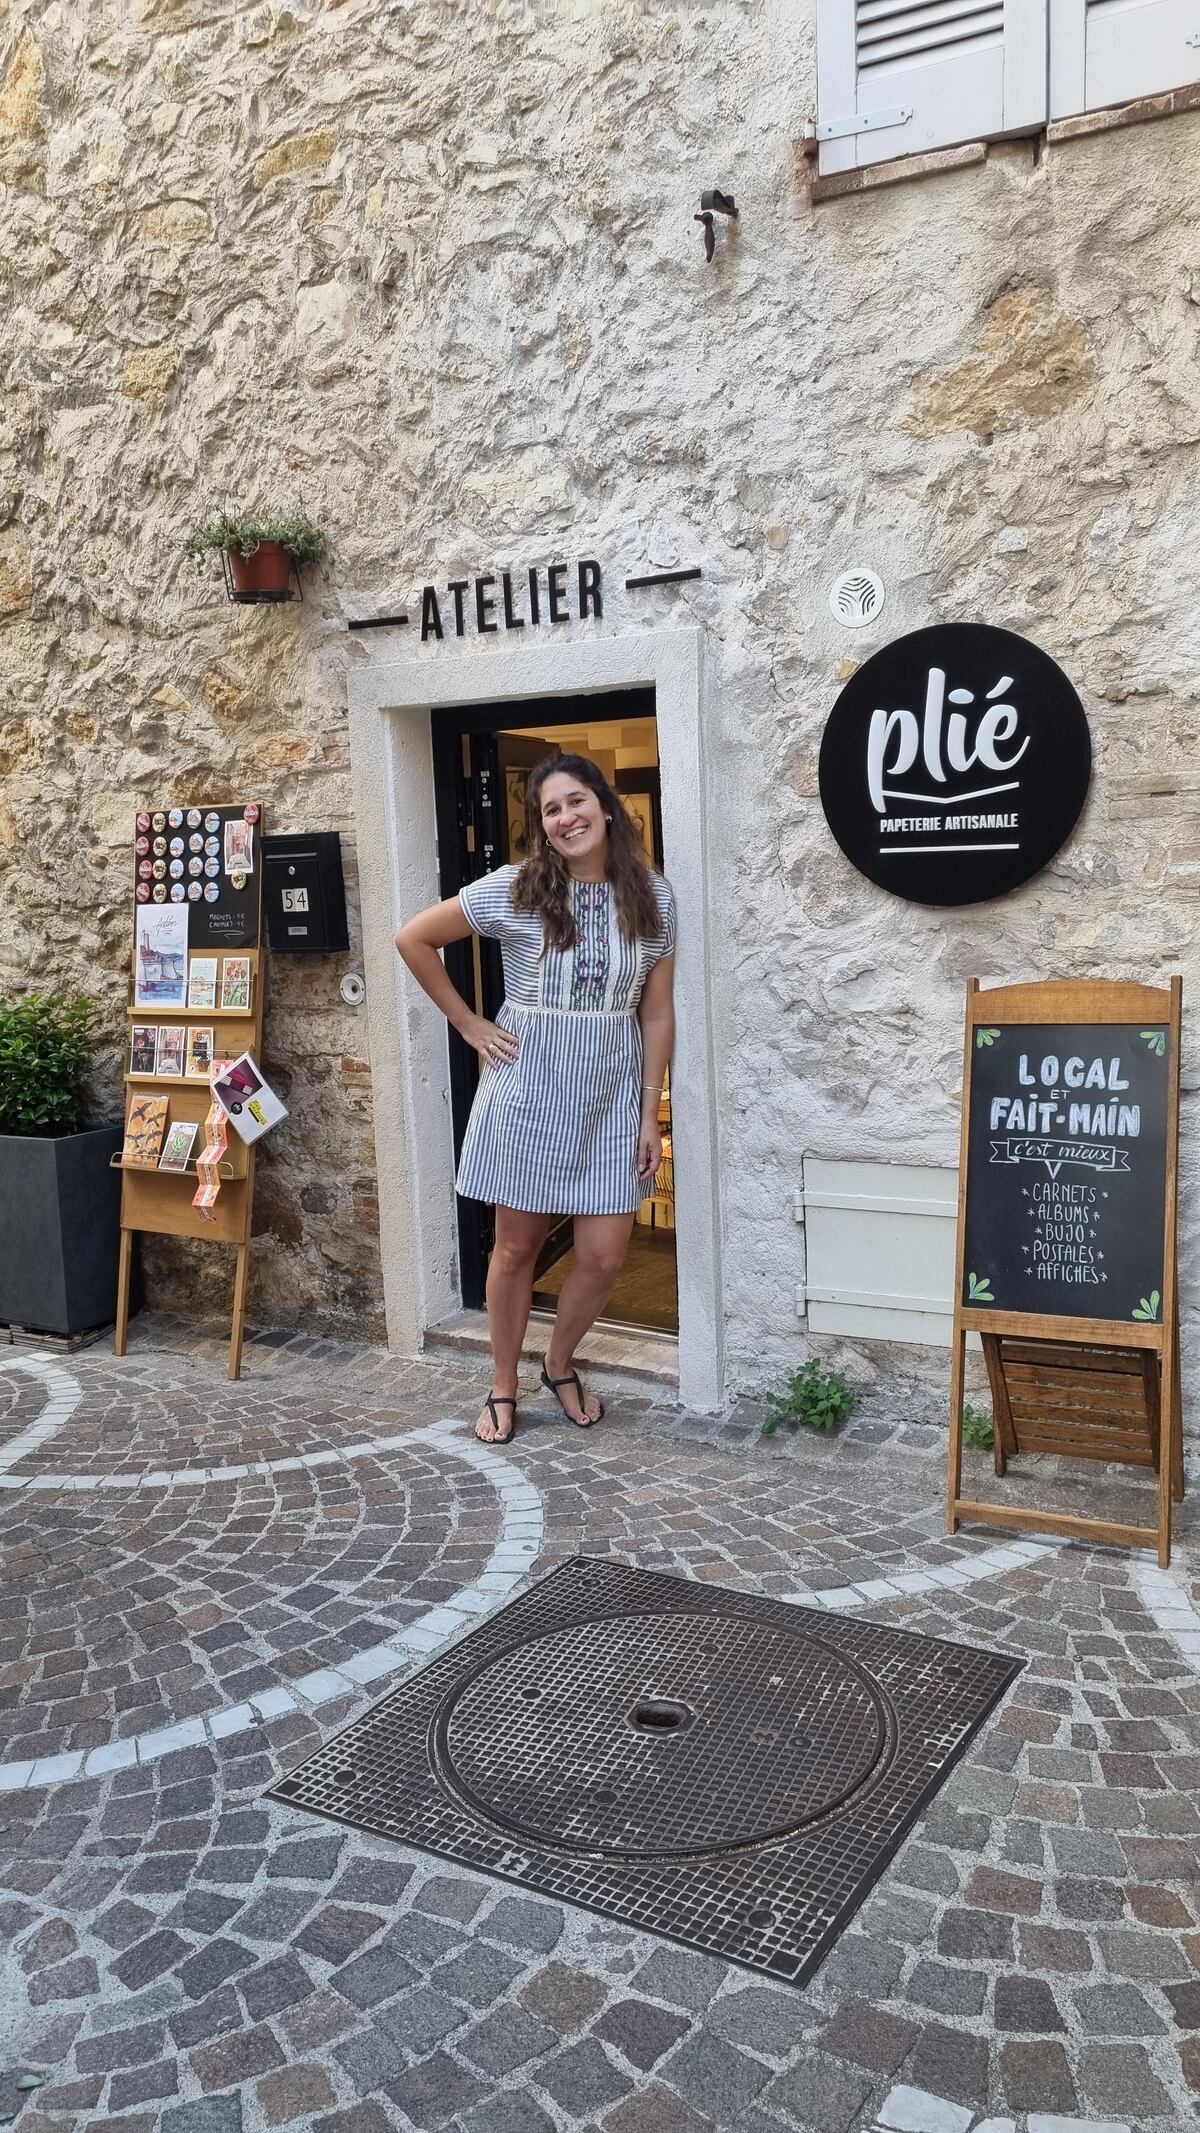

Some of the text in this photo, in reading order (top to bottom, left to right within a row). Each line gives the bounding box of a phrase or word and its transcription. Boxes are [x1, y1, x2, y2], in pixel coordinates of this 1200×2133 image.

[421, 560, 603, 641] ATELIER
[867, 667, 1031, 813] plié
[880, 813, 1018, 832] PAPETERIE ARTISANALE
[285, 891, 306, 909] 54
[1019, 1054, 1129, 1090] LOCAL
[1050, 1089, 1071, 1100] ET
[1014, 1141, 1110, 1161] c'est mieux
[1033, 1182, 1096, 1203] CARNETS
[1038, 1203, 1089, 1223] ALBUMS
[1045, 1223, 1085, 1243] BUJO
[1033, 1239, 1094, 1264] POSTALES
[1036, 1262, 1099, 1284] AFFICHES
